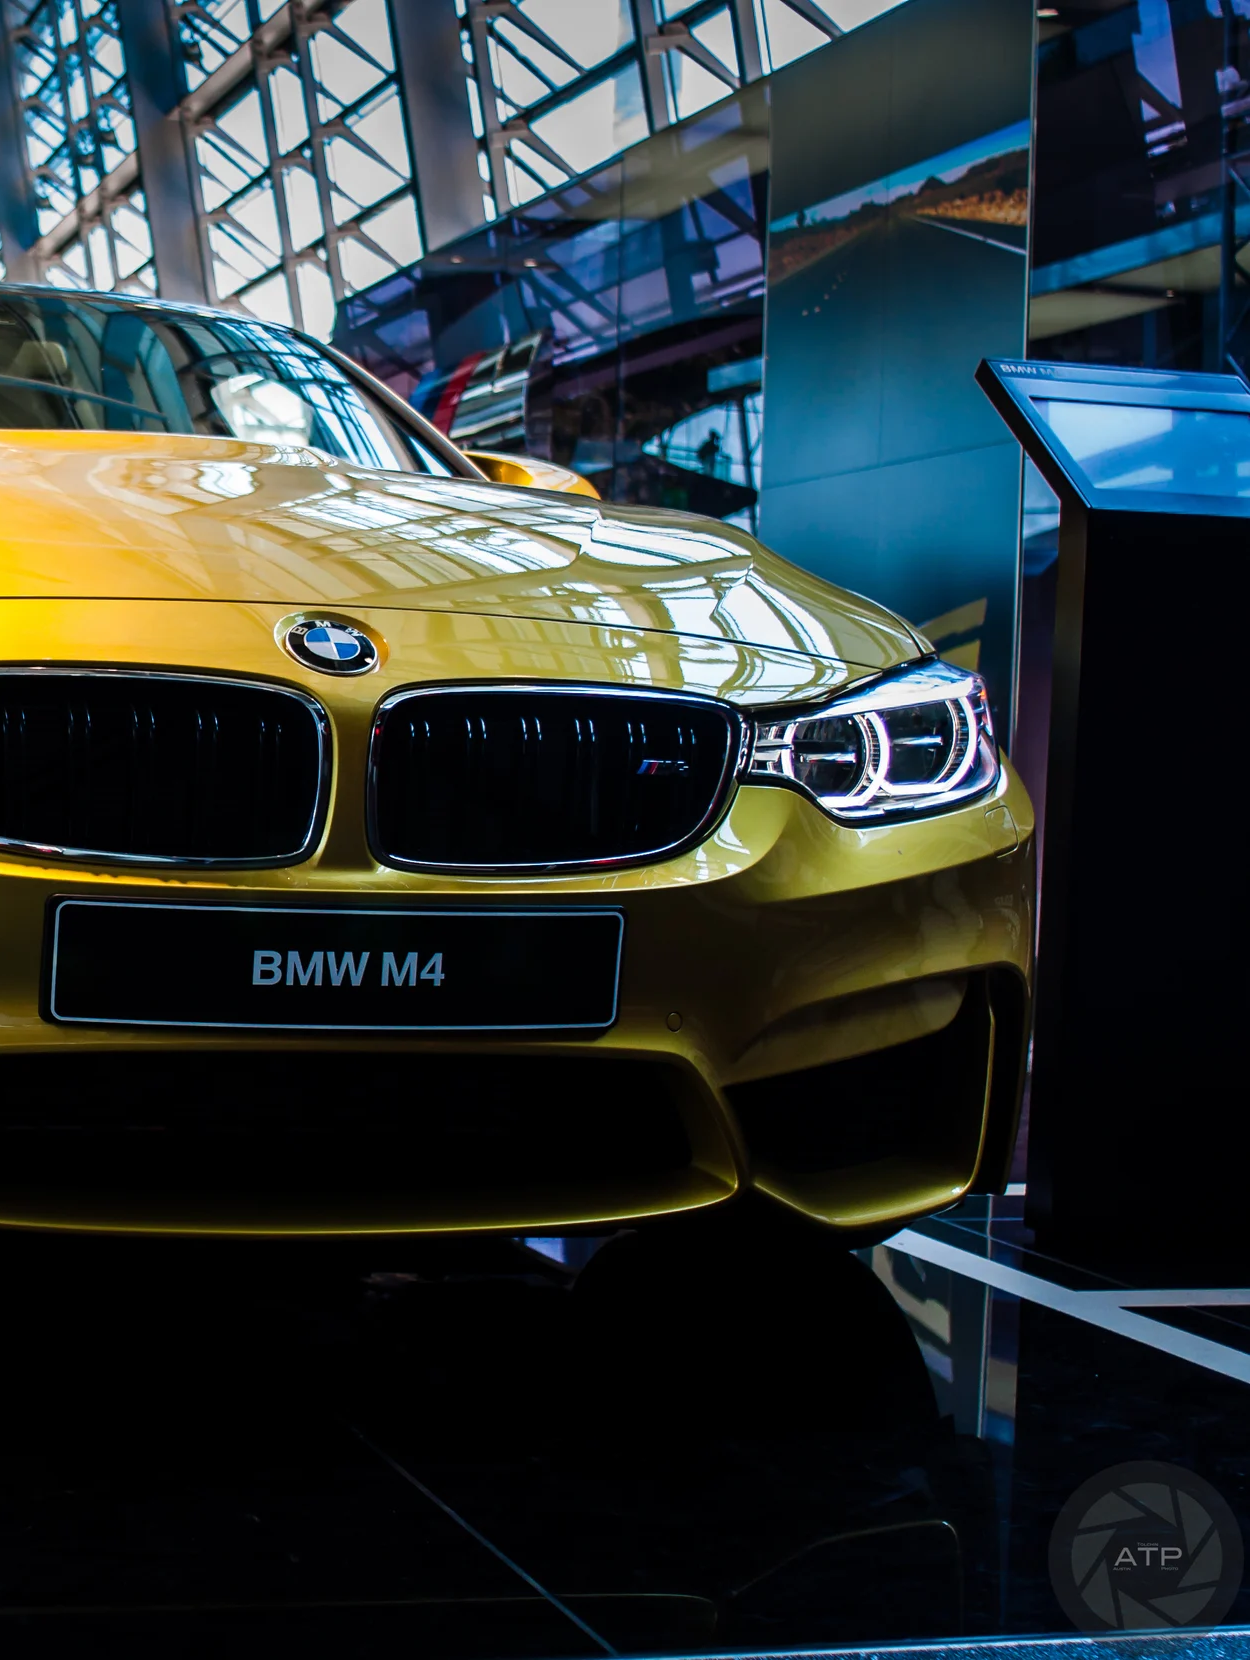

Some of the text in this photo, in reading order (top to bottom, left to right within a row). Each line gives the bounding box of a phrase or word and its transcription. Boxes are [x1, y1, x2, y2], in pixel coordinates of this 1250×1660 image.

[1000, 364, 1037, 375] BMW
[291, 620, 366, 637] BMW
[252, 950, 445, 987] BMW M4
